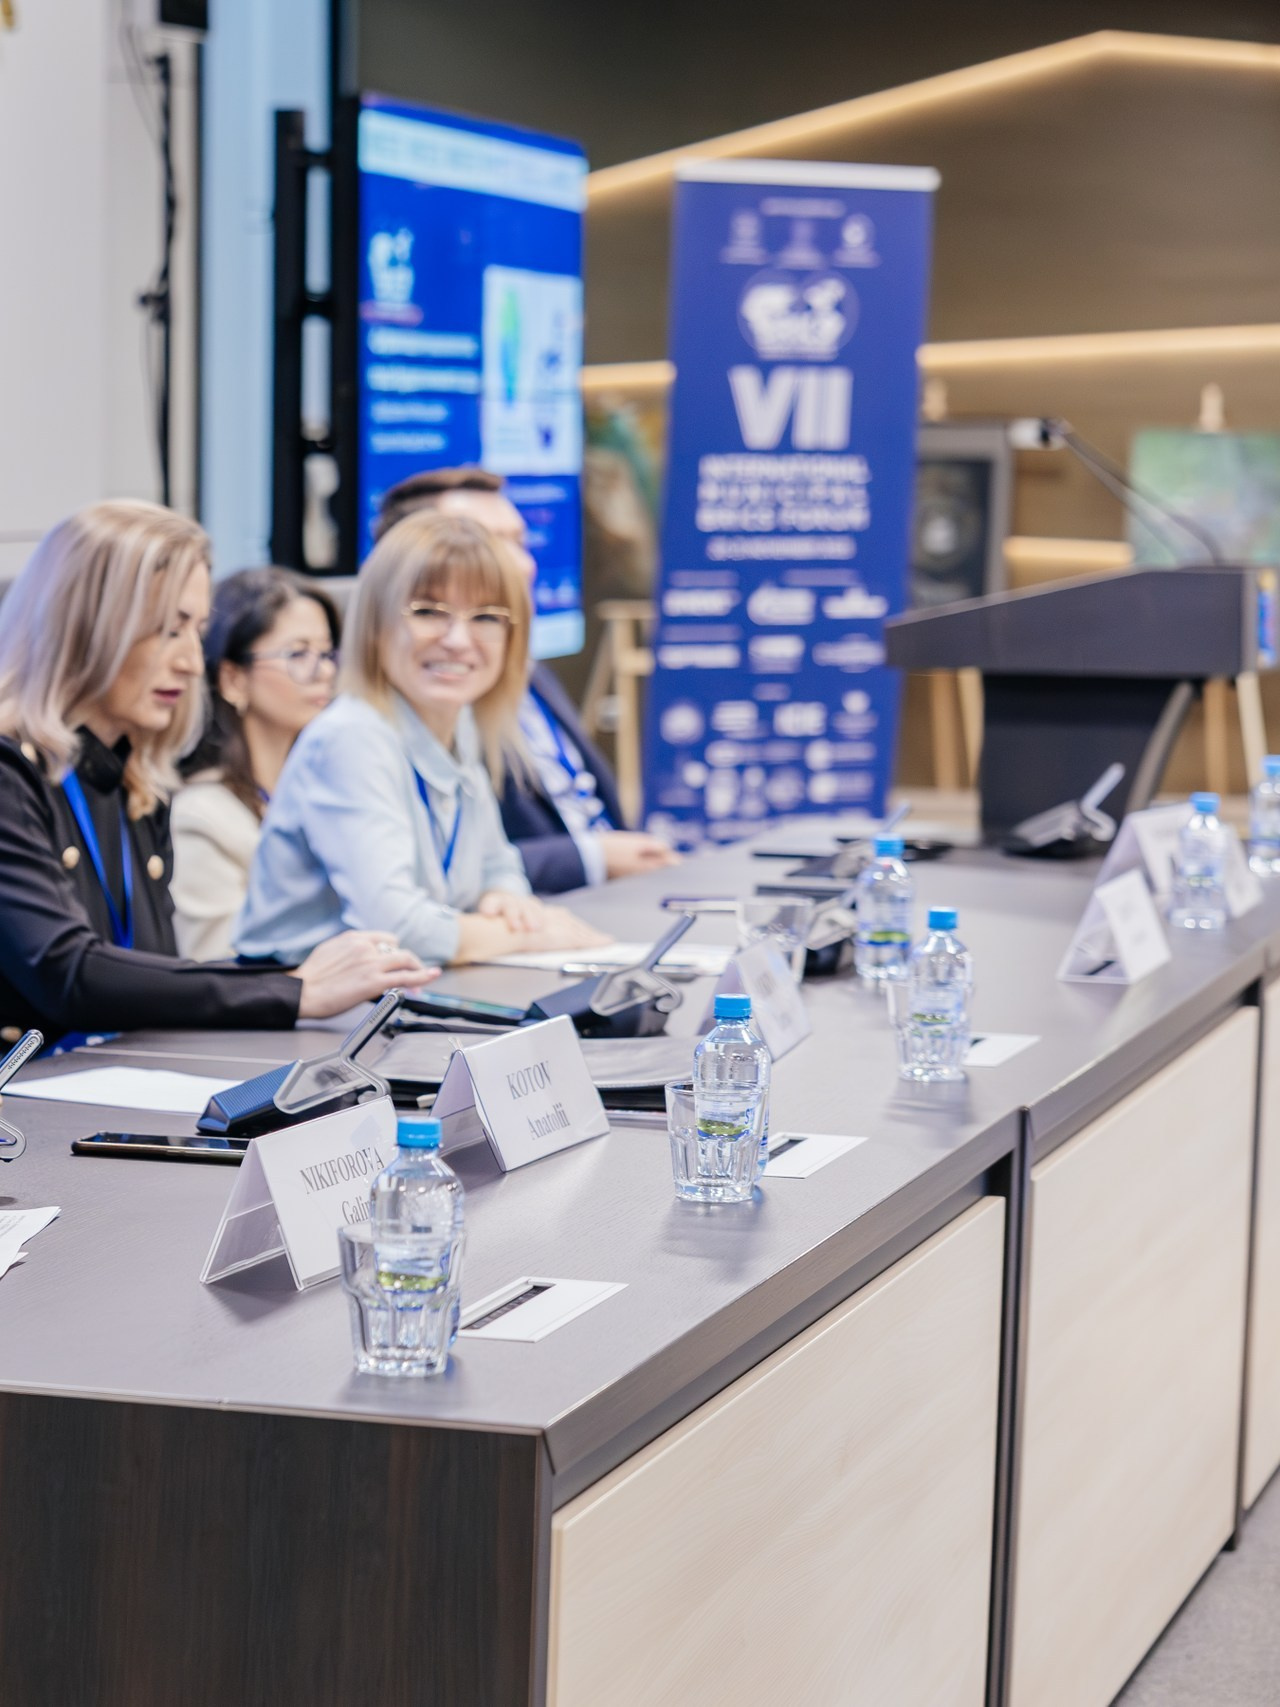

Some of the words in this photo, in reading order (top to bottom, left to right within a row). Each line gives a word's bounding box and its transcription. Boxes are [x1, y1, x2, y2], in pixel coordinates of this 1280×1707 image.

[726, 363, 855, 451] VII
[505, 1060, 552, 1100] KOTOV
[299, 1147, 386, 1195] NIKIFOROVA
